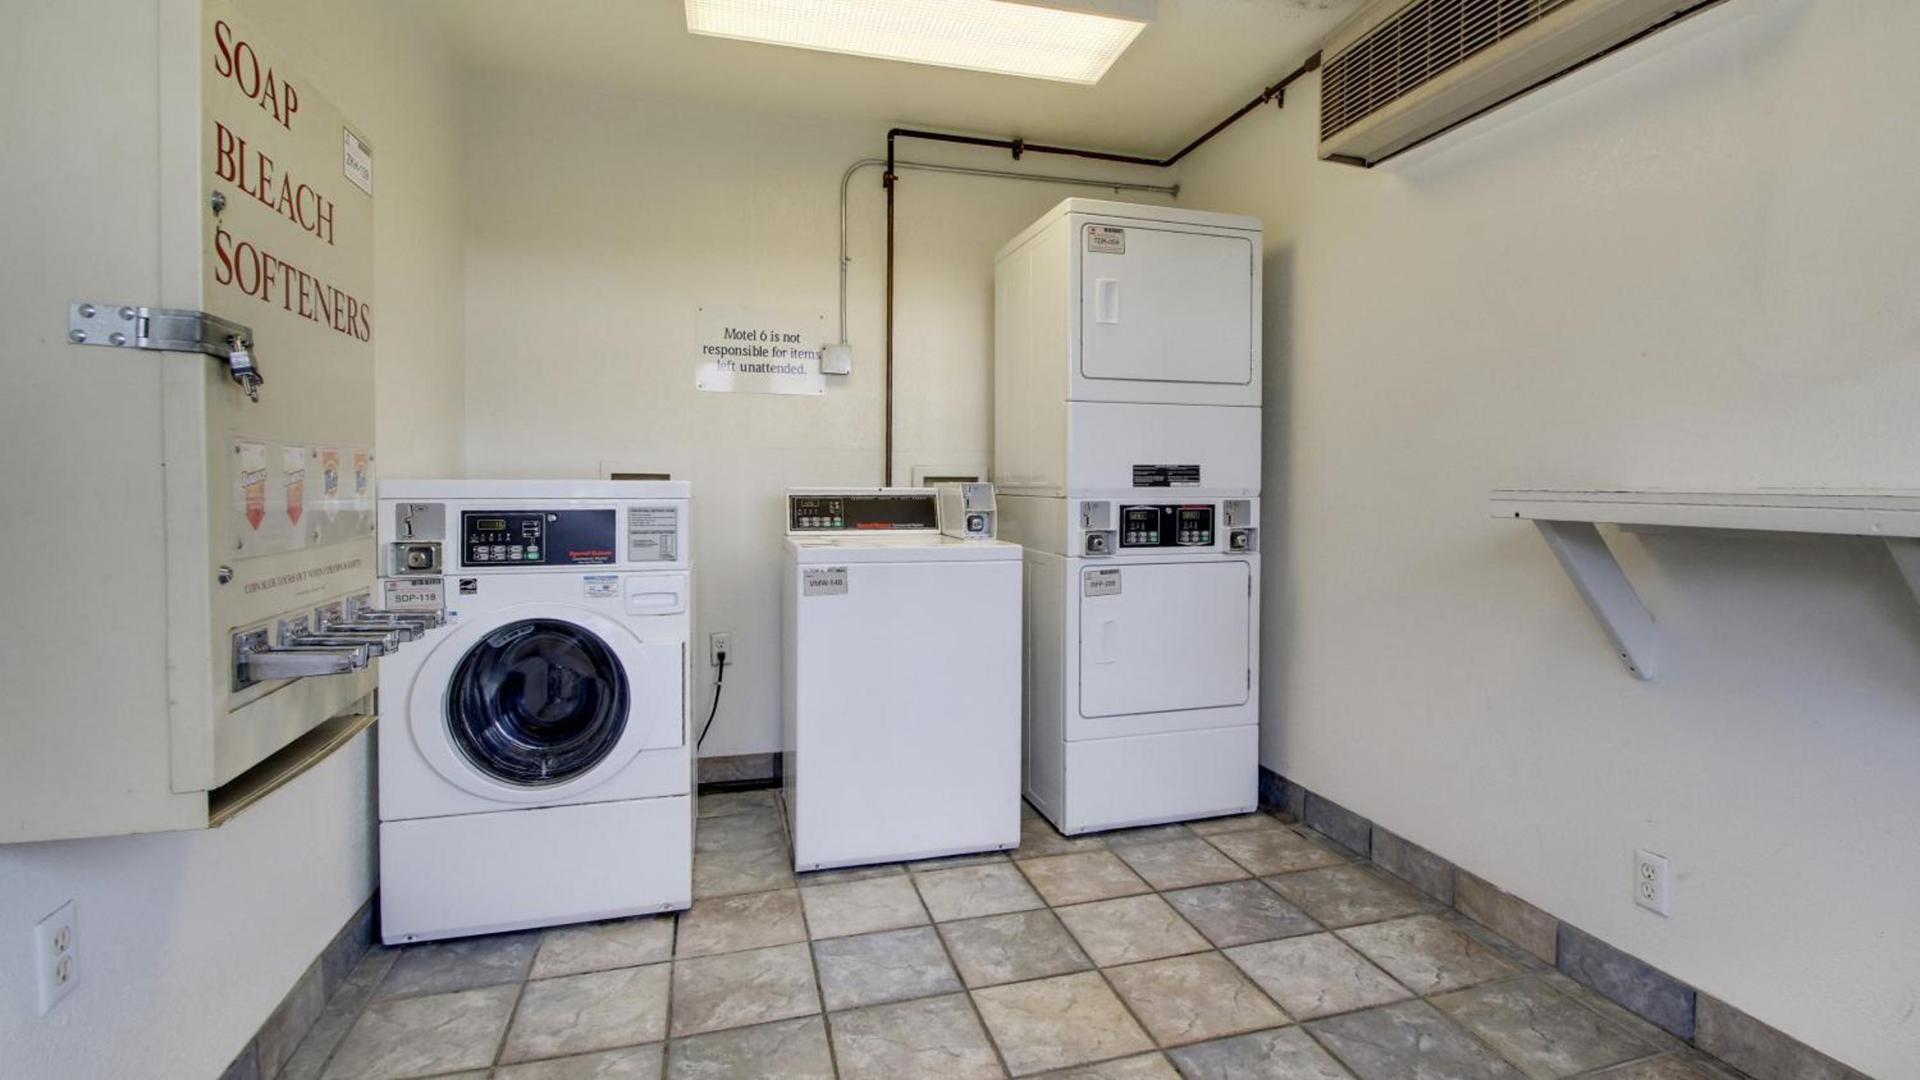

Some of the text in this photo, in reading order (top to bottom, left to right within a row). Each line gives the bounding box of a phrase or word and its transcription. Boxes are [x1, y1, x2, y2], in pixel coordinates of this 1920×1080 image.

[214, 20, 298, 131] SOAP
[214, 120, 335, 246] BLEACH
[214, 229, 371, 343] SOFTENERS
[702, 344, 821, 360] responsible for items
[717, 359, 808, 375] left unattended.
[723, 327, 801, 344] Motel 6 is not
